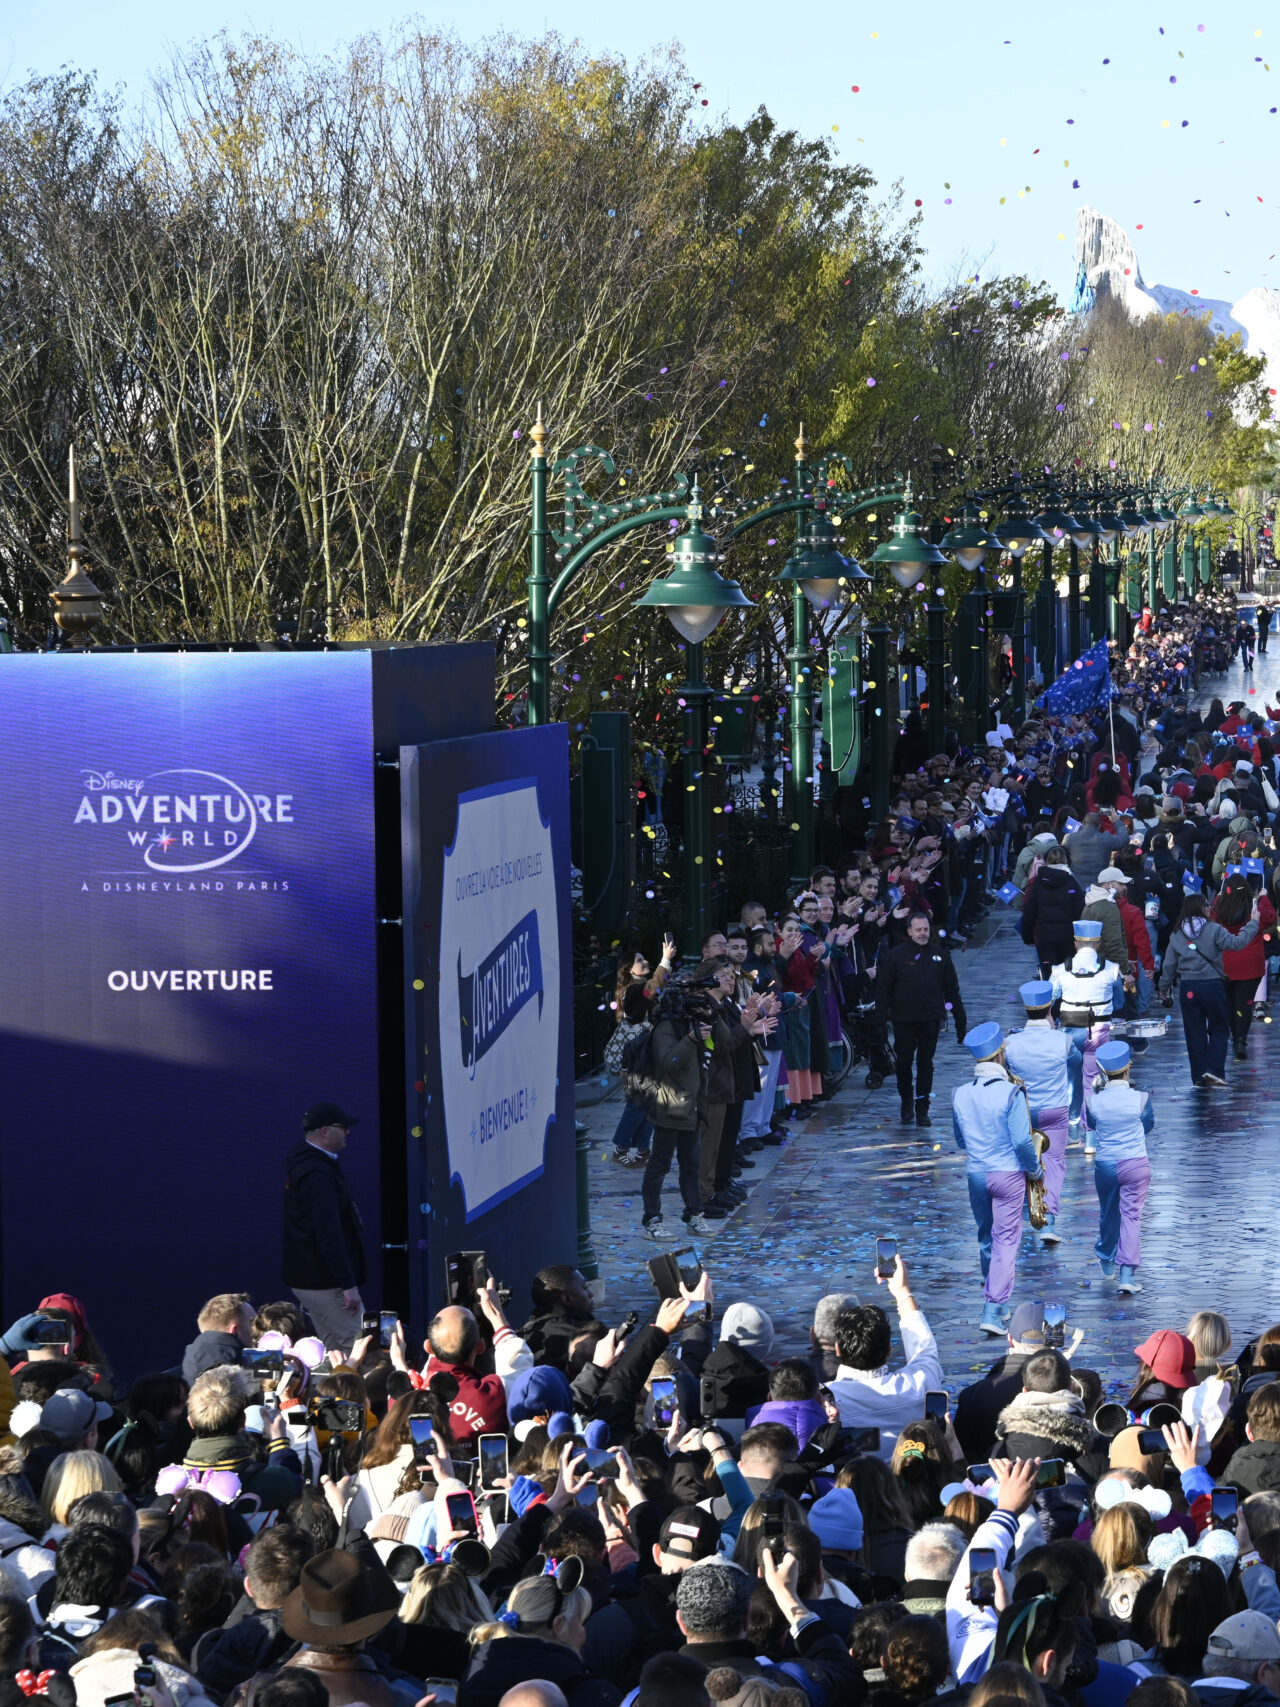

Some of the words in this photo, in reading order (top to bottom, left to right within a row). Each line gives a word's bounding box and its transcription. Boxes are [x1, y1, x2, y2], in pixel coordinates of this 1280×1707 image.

[73, 794, 294, 824] ADVENTURE
[103, 880, 225, 892] DISNEYLAND
[237, 880, 289, 892] PARIS
[107, 969, 273, 992] OUVERTURE
[467, 931, 531, 1081] AVENTURES
